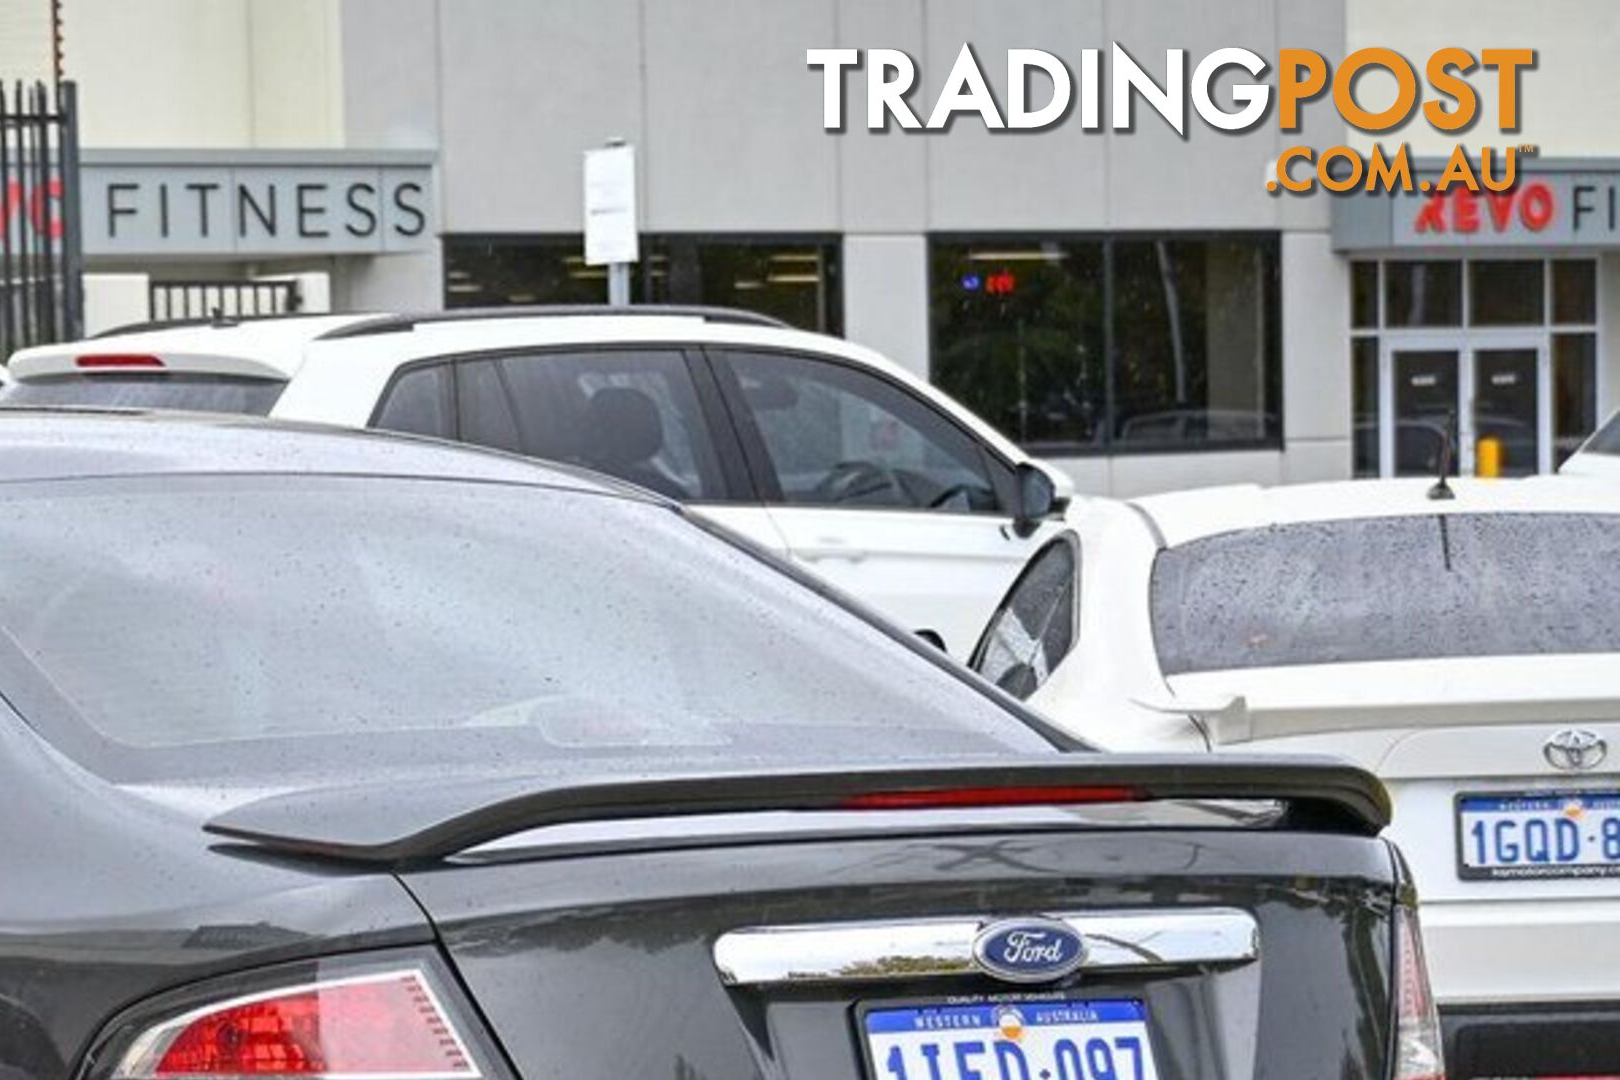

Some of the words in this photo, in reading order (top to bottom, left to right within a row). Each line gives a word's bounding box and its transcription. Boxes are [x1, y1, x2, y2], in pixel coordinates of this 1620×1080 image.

[107, 183, 426, 238] FITNESS
[1003, 931, 1063, 963] Ford
[914, 1014, 981, 1029] WESTERN
[1036, 1010, 1099, 1024] AUSTRALIA
